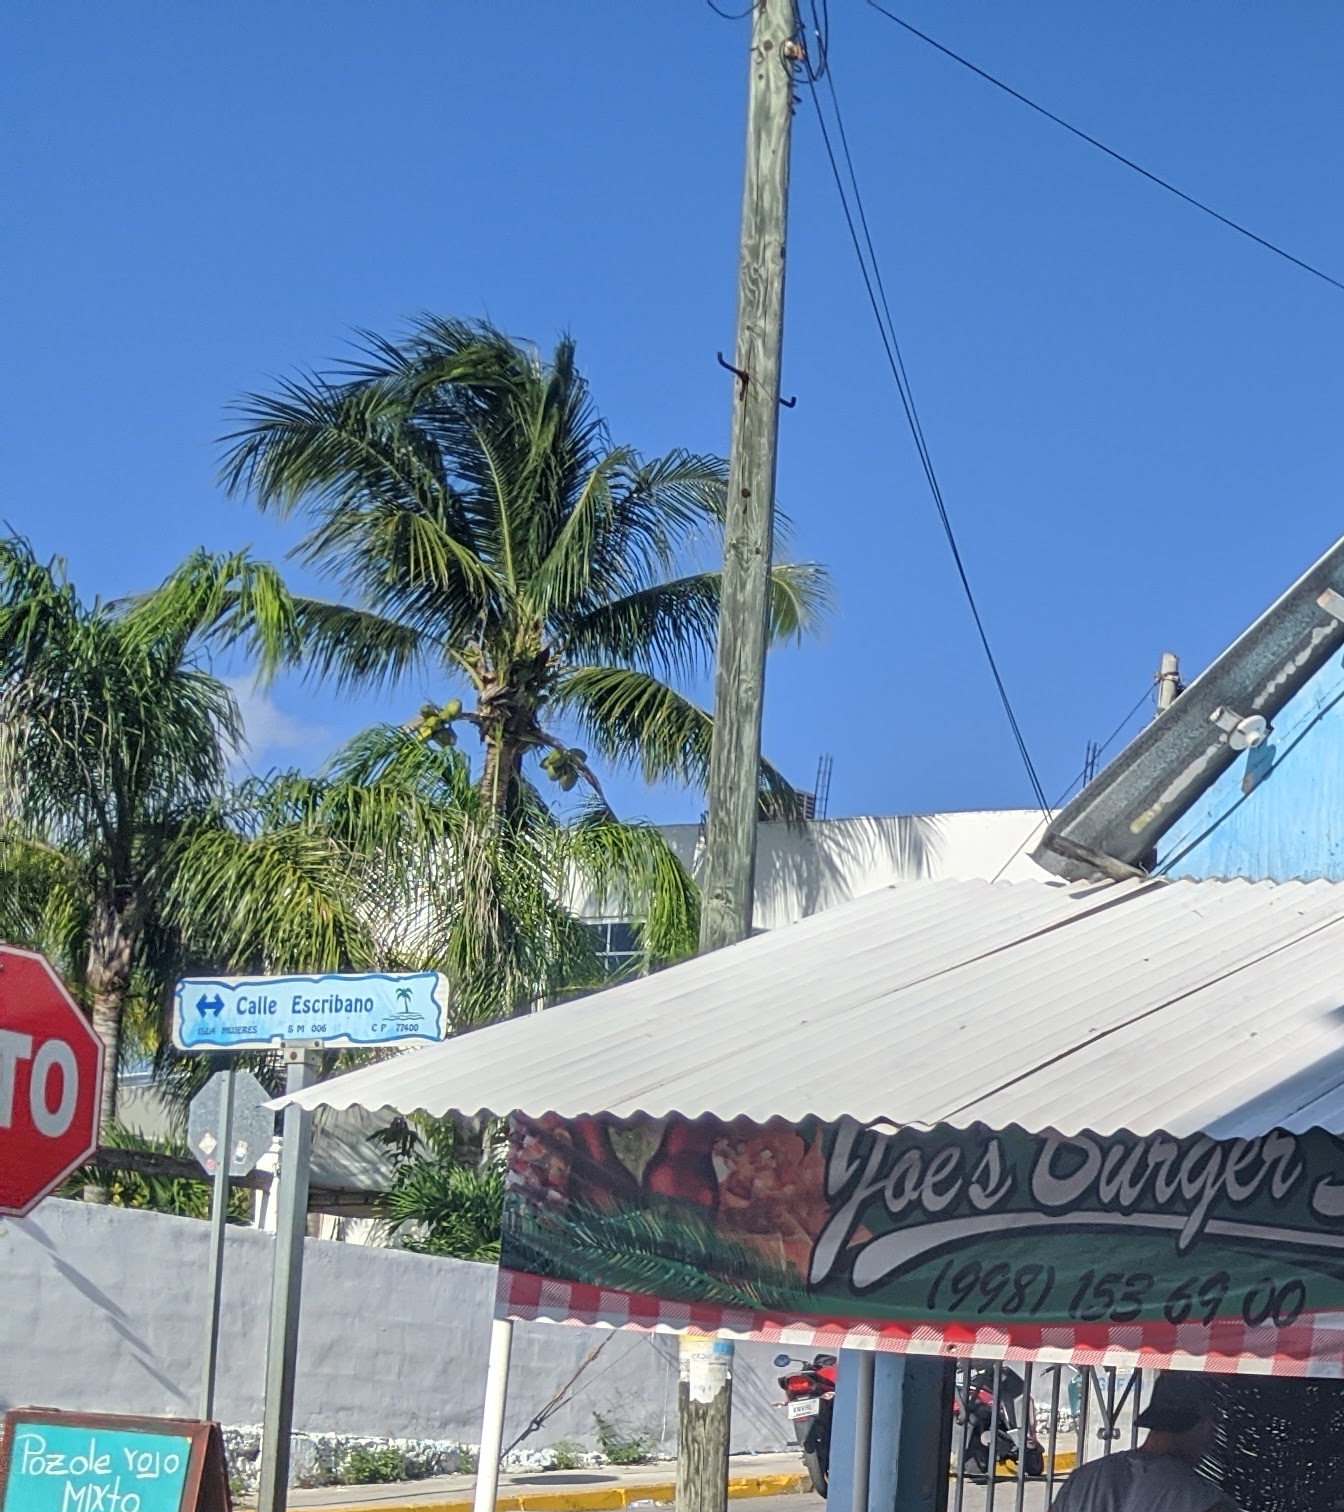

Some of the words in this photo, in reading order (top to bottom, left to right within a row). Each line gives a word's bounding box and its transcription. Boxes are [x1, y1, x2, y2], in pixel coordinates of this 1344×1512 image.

[236, 995, 277, 1015] Calle
[291, 995, 374, 1014] Escribano
[197, 1027, 216, 1036] ISLA
[395, 1023, 419, 1032] 77400
[925, 1258, 1056, 1315] (998)
[1067, 1268, 1154, 1323] 153
[1163, 1271, 1232, 1327] 69
[1241, 1276, 1307, 1329] 00
[16, 1433, 112, 1475] Pozole
